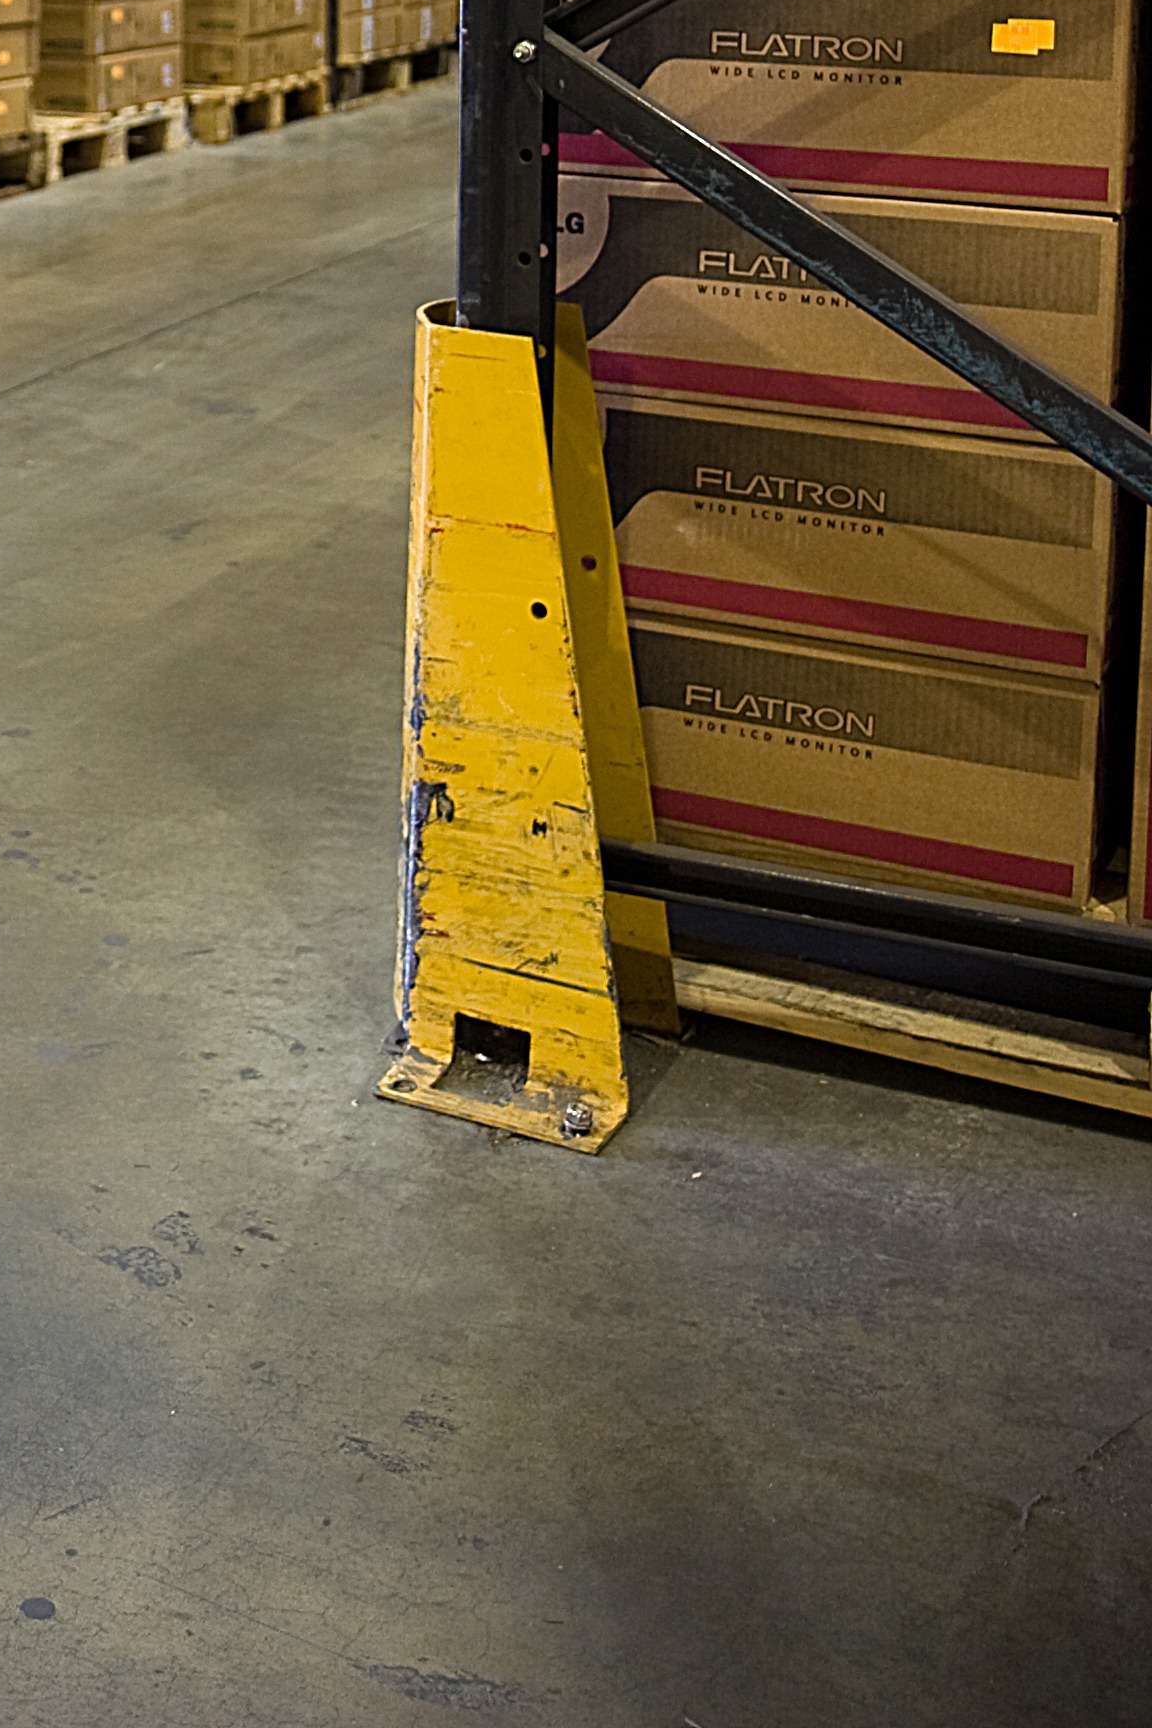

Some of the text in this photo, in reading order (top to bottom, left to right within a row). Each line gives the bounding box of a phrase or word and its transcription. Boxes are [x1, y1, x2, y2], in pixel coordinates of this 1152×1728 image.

[710, 31, 904, 64] FLATRON
[709, 65, 903, 87] WIDE LCD MONITOR
[699, 250, 808, 282] FLAT
[697, 285, 742, 299] WIDE
[754, 290, 788, 303] LCD
[695, 466, 887, 514] FLATRON
[694, 501, 886, 537] WIDE LCD MONITOR
[685, 683, 876, 738] FLATRON
[683, 717, 874, 760] WIDE LCD MONITOR
